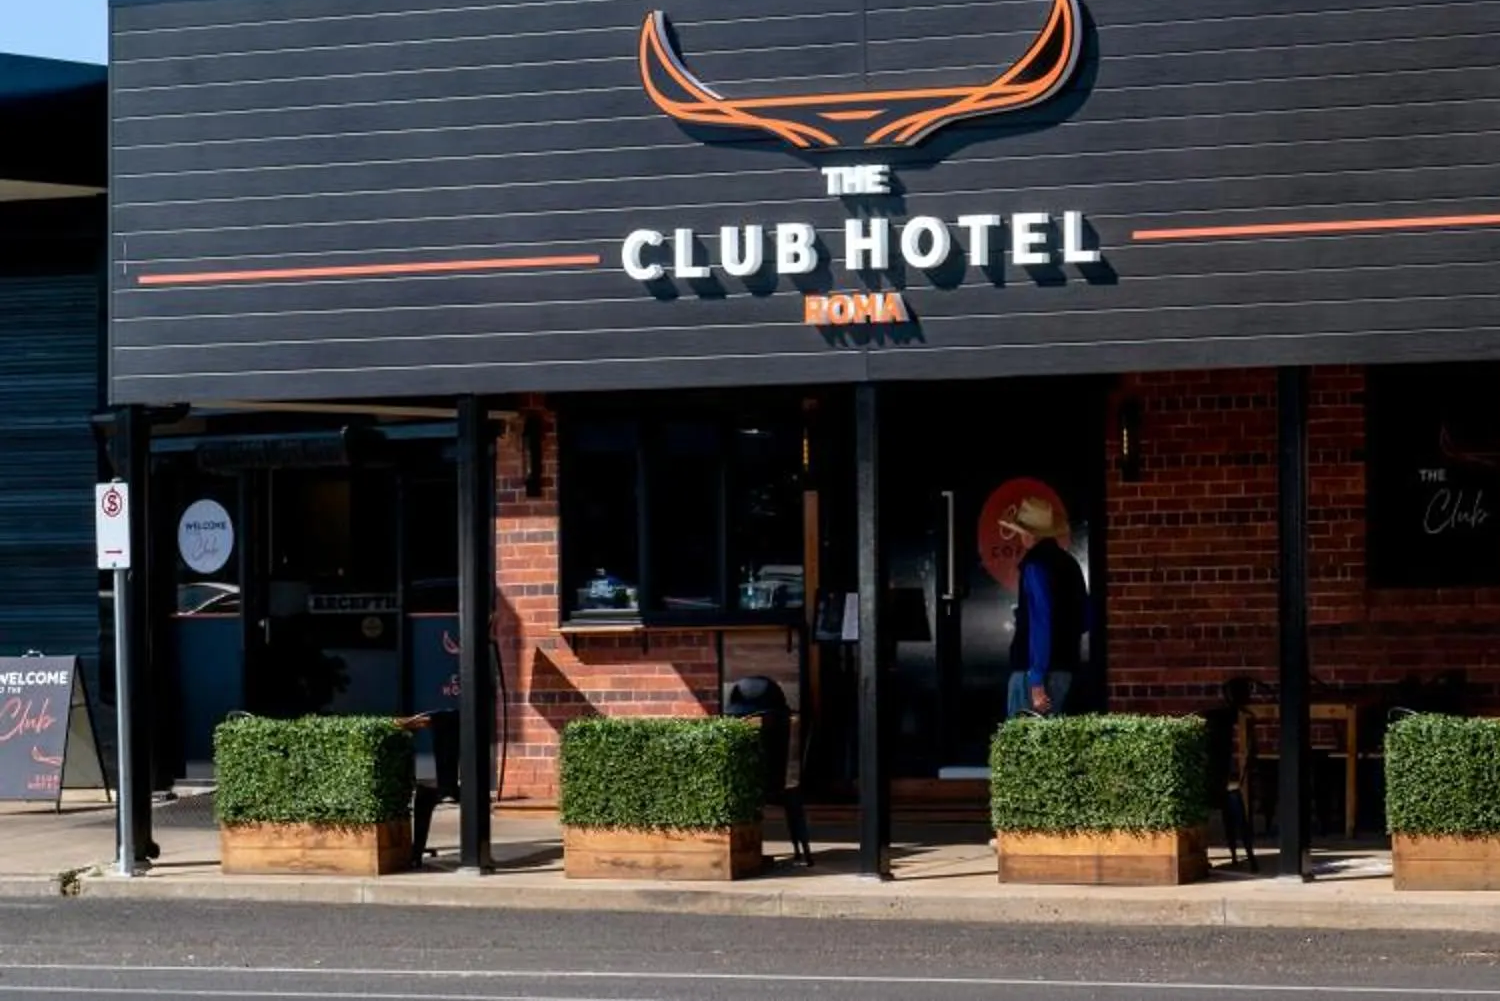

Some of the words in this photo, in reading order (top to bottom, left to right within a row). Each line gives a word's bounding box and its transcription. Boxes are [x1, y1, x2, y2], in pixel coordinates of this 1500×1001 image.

[821, 164, 891, 195] THE
[621, 222, 818, 280] CLUB
[844, 210, 1101, 270] HOTEL
[804, 291, 908, 325] ROMA
[1417, 468, 1448, 483] THE
[186, 520, 227, 532] WELCOME
[1423, 487, 1492, 535] Club
[0, 697, 56, 742] Club
